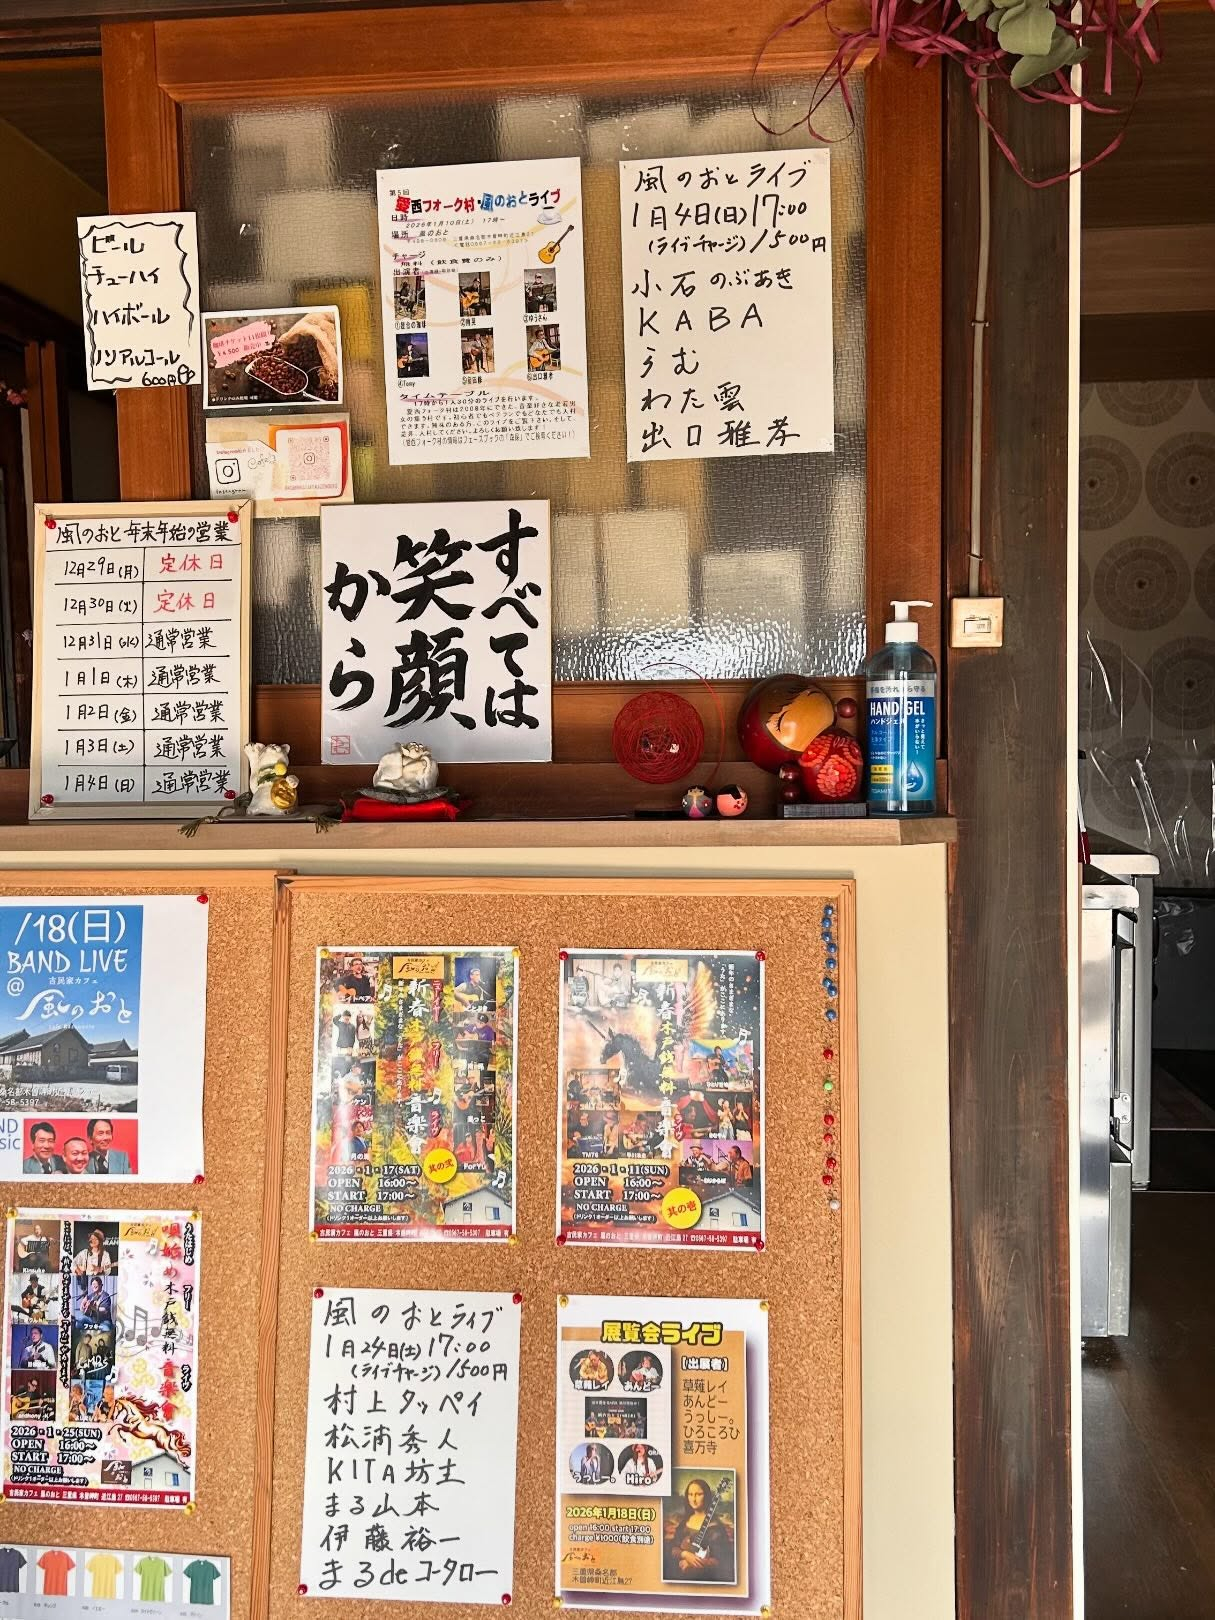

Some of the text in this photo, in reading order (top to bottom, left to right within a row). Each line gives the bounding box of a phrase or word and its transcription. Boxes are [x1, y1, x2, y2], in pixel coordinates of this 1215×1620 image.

[92, 234, 145, 254] ビール
[88, 265, 160, 287] チューハイ
[93, 302, 171, 326] ハイボール
[639, 303, 763, 337] KABA
[640, 346, 700, 378] うむ
[641, 381, 745, 414] わた雲
[641, 416, 801, 453] 出口雅孝
[63, 553, 224, 580] 12月29日(月) 定休日
[153, 589, 216, 613] 定休日
[323, 561, 392, 712] から
[383, 528, 477, 731] 笑顔
[145, 627, 217, 654] 通常営業
[65, 663, 221, 689] 1月1日(木) 通常営業
[151, 699, 226, 726] 通常営業
[870, 701, 926, 716] HAND GEL
[65, 734, 227, 761] 1月3日(土) 通常営業
[65, 769, 231, 795] 1月4日(日) 通常営業
[7, 949, 129, 974] BAND LIVE
[6, 977, 25, 997] @
[48, 976, 98, 985] 古民家カフェ
[327, 1178, 361, 1189] OPEN
[574, 1176, 606, 1187] OPEN
[327, 1191, 366, 1201] START
[573, 1190, 612, 1200] START
[329, 1204, 381, 1213] NO CHARGE
[576, 1203, 627, 1212] NO CHARGE
[601, 1320, 724, 1346] 展覧会ライブ
[682, 1378, 728, 1393] 草薙レイ
[682, 1394, 729, 1409] あんどー
[684, 1409, 735, 1425] うっしー。
[12, 1439, 44, 1450] OPEN
[324, 1423, 458, 1456] 松浦秀人
[683, 1440, 718, 1456] 喜万寺
[12, 1451, 48, 1463] START
[13, 1464, 62, 1475] NO CHARGE
[566, 1506, 657, 1521] 2026年1月18日(日)
[320, 1522, 461, 1552] 伊藤裕一
[569, 1523, 651, 1534] open 16:00 start 17:00
[569, 1534, 594, 1543] charge
